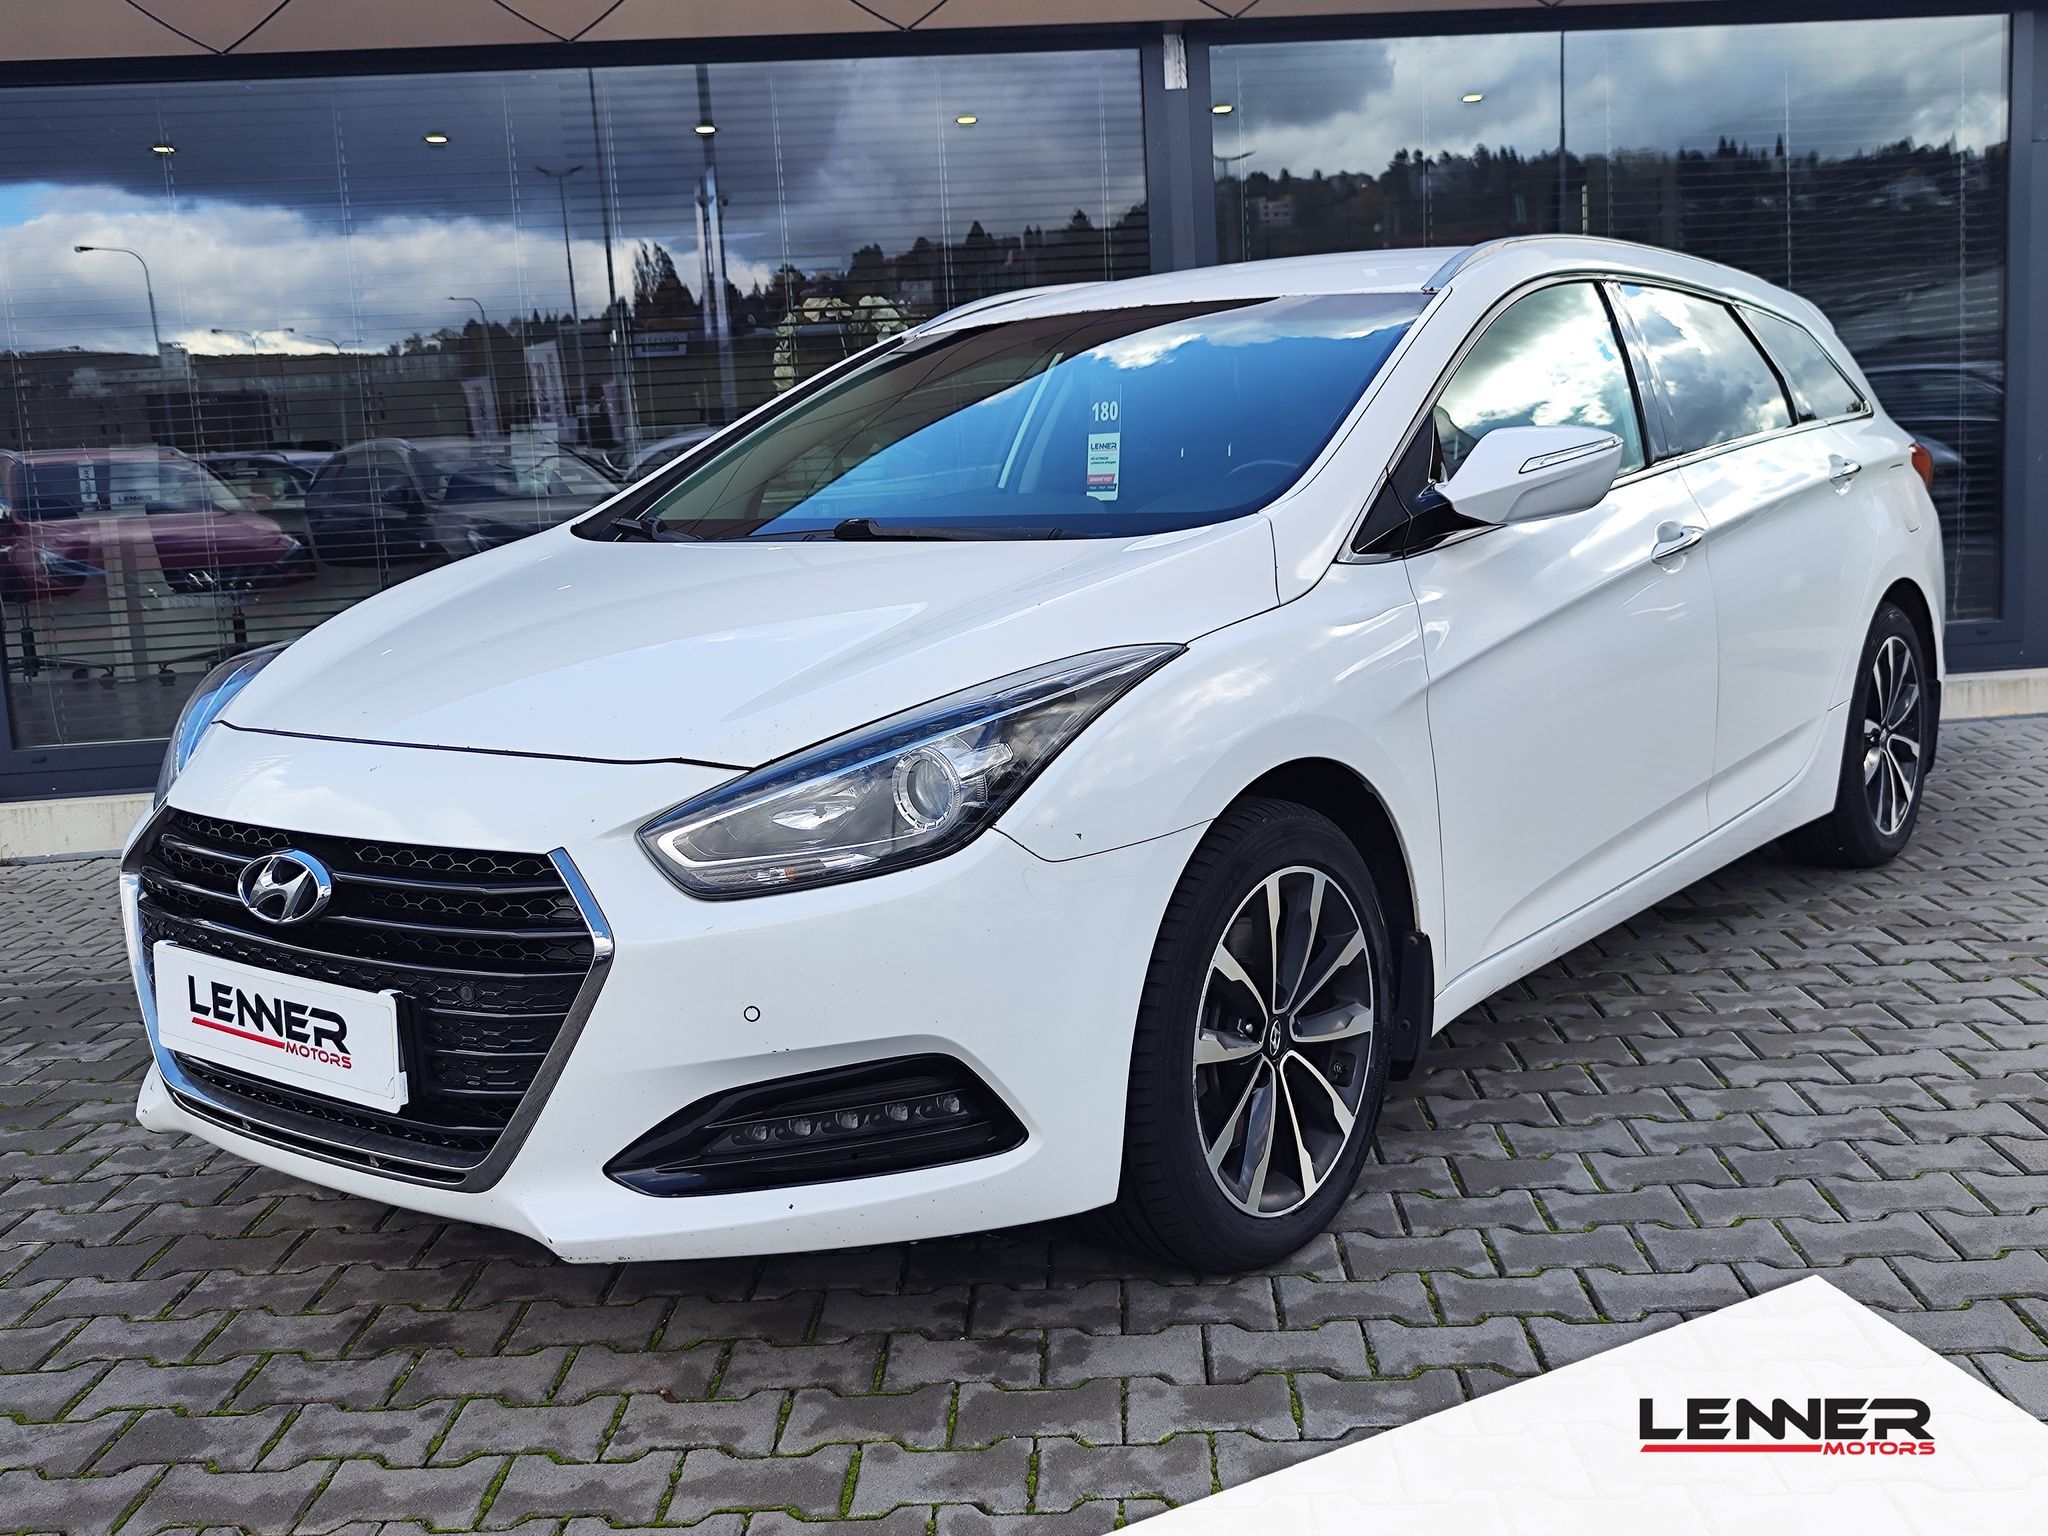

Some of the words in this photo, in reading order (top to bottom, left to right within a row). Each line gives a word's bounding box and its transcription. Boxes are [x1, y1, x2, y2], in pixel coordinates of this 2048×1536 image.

[1092, 400, 1118, 421] 180
[1090, 442, 1117, 450] LENNER
[187, 974, 352, 1055] LENNER
[285, 1041, 353, 1070] MOTORS
